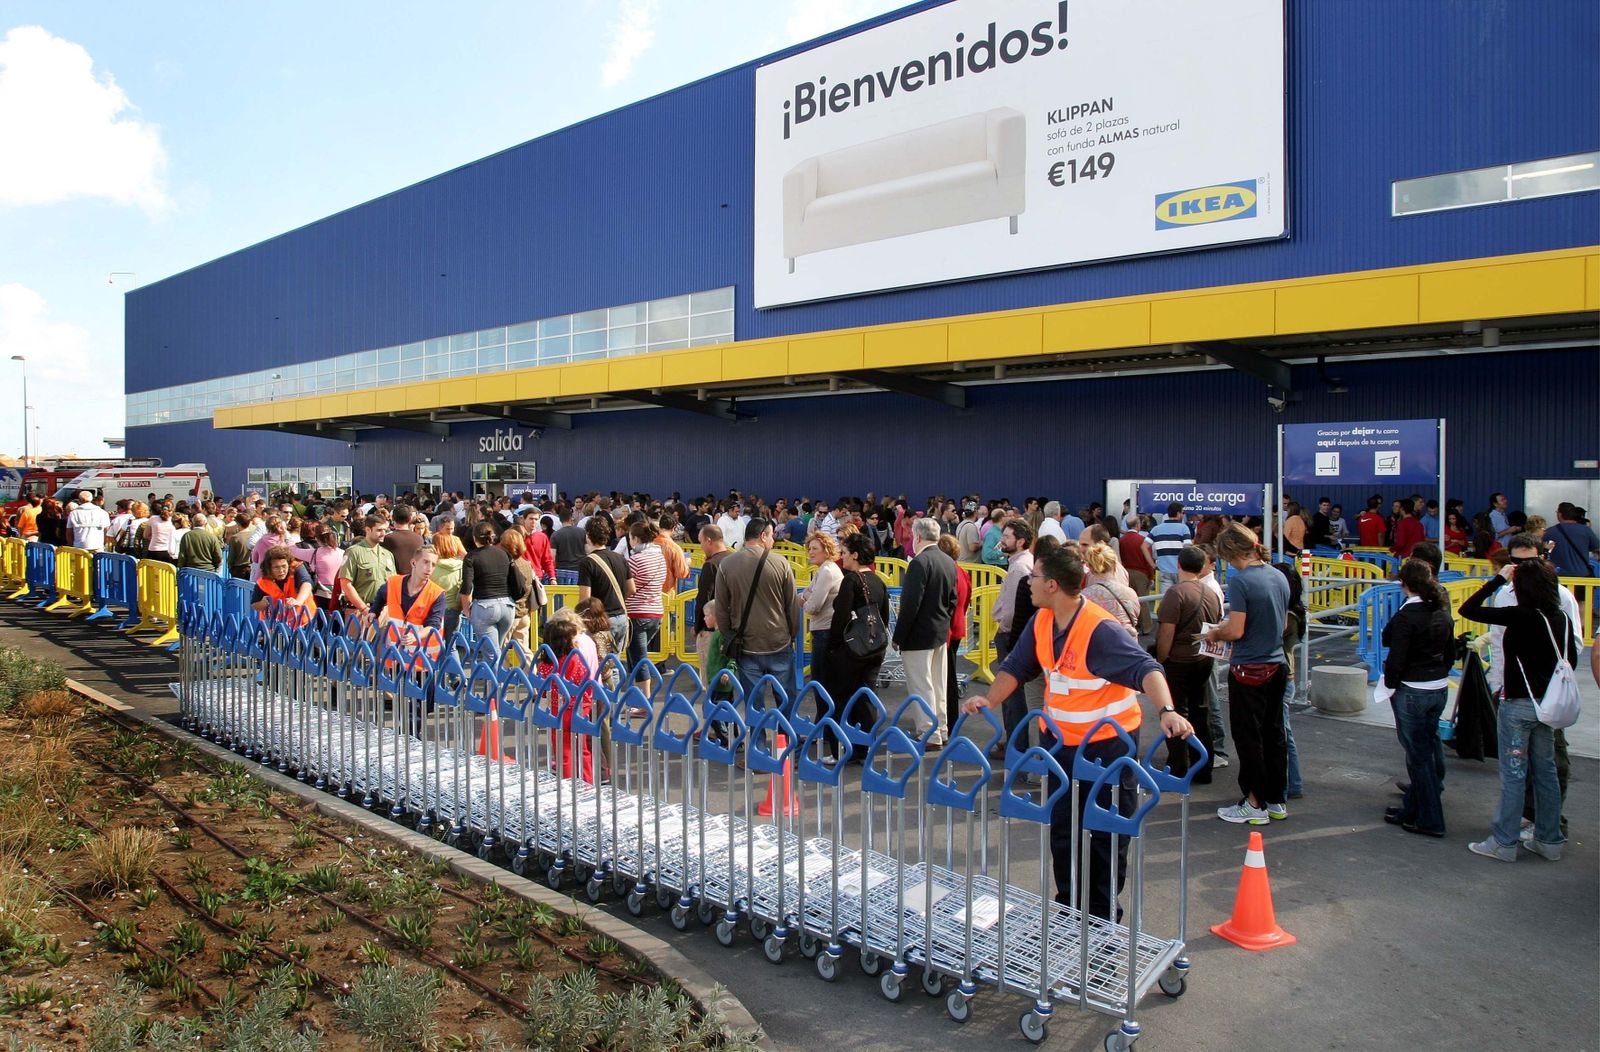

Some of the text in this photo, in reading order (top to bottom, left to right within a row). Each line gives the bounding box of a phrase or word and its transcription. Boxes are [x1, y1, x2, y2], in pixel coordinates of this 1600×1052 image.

[783, 0, 1069, 140] ¡Bienvenidos!
[1047, 97, 1113, 125] KLIPPAN
[1047, 116, 1130, 141] sofá de 2 plazas
[1047, 119, 1181, 156] con funda ALMAS natural
[1047, 152, 1115, 187] €149
[1168, 192, 1246, 218] IKEA
[479, 427, 523, 452] salida
[1317, 438, 1336, 448] aquí
[1352, 427, 1375, 436] dejar
[1153, 486, 1246, 507] zona de carga
